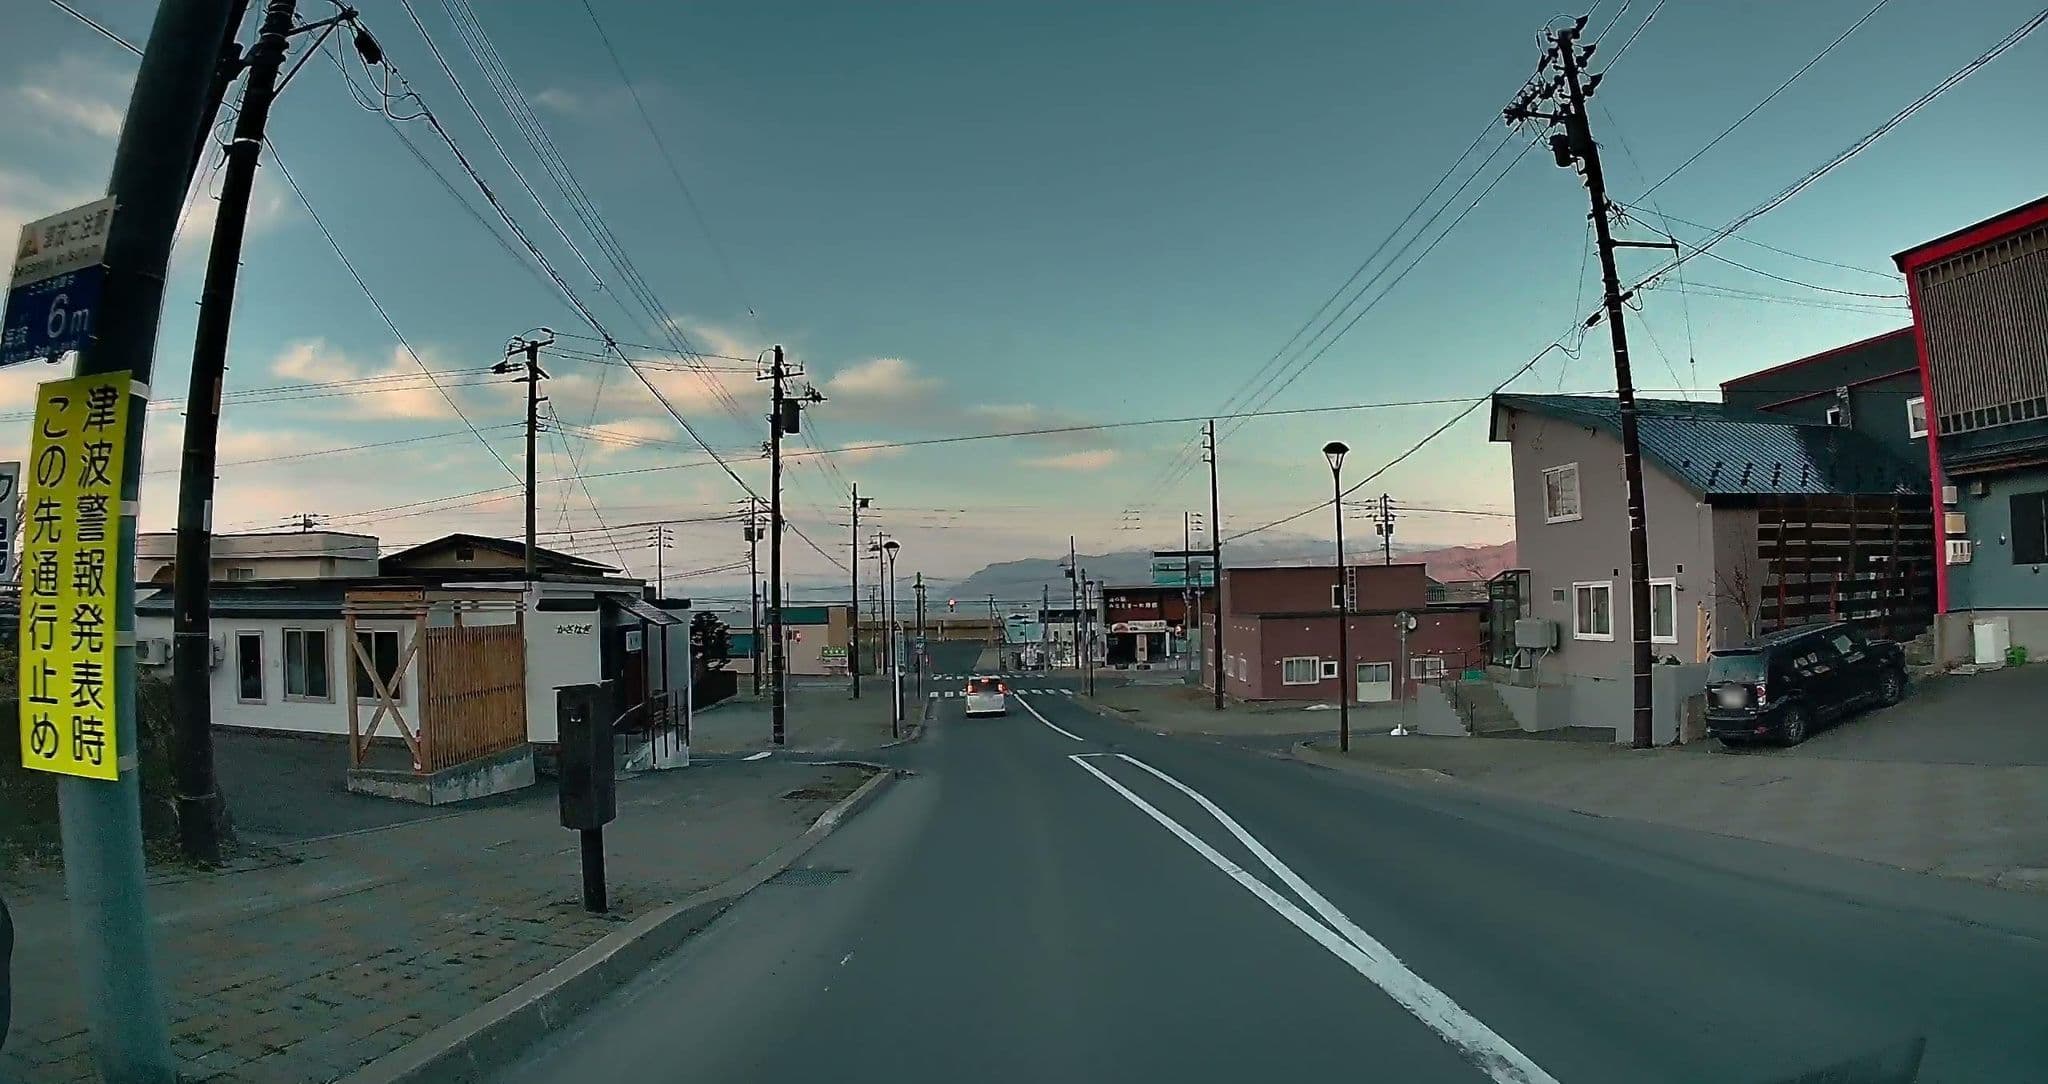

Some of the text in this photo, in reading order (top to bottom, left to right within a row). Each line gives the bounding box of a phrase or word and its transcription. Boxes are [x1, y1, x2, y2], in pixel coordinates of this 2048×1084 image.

[29, 396, 70, 759] この先通行止め
[70, 384, 120, 766] 津波警報発表時
[557, 624, 593, 635] かざなぎ
